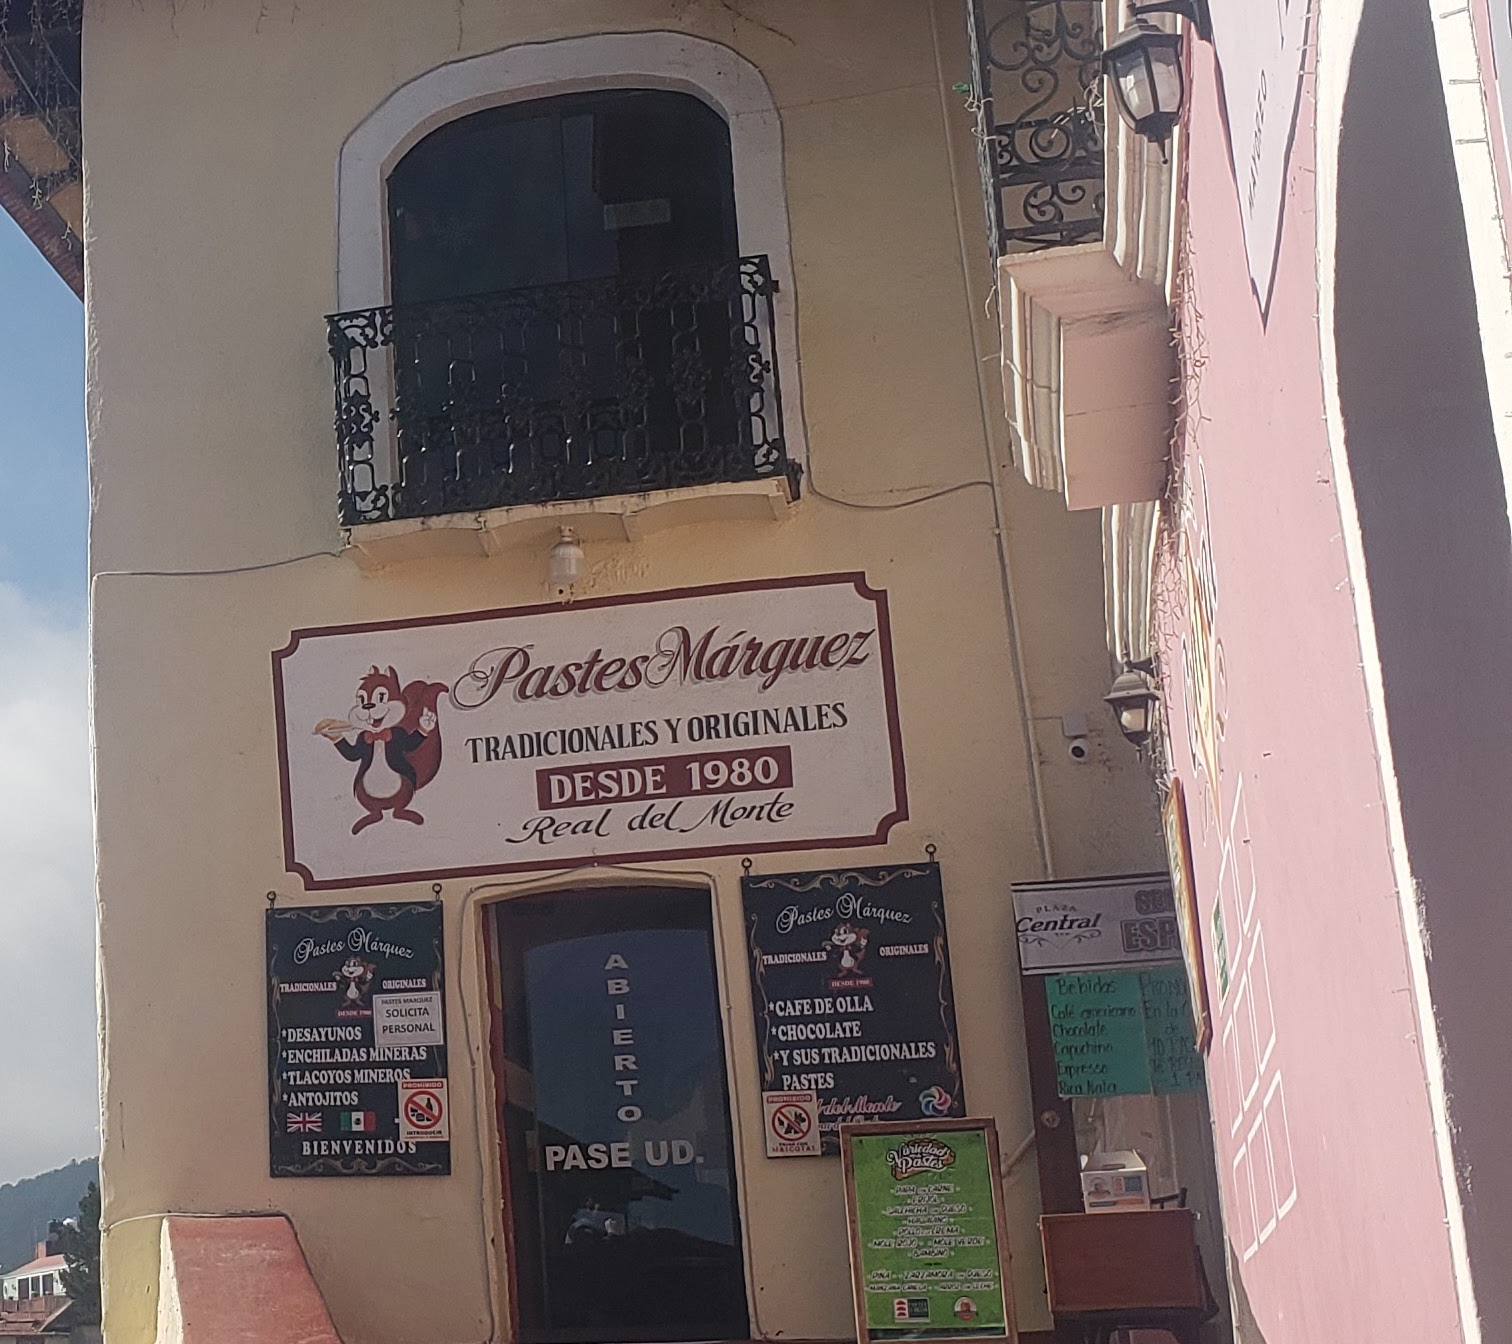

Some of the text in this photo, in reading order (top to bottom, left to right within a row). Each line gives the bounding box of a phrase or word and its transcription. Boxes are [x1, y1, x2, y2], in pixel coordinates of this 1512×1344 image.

[1247, 67, 1268, 220] MAYOREO
[451, 643, 650, 709] Pastes
[464, 702, 848, 763] TRADICIONALES Y ORIGINALES
[548, 756, 780, 804] DESDE 1980
[505, 791, 795, 844] Real del Monte
[776, 892, 912, 933] Pastes Márquez
[1036, 905, 1077, 913] PLAZA
[1016, 912, 1102, 933] Central
[293, 927, 414, 964] Pastes Márquez
[762, 943, 929, 965] TRADICIONALES ORIGINALES
[280, 978, 427, 993] TRADICIONALES ORIGINALES
[1055, 976, 1118, 996] Bebidas
[386, 1006, 430, 1018] SOLICITA
[775, 995, 874, 1016] CAFE DE OLLA
[287, 1026, 362, 1043] DESAYUNOS
[382, 1022, 436, 1034] PERSONAL
[604, 953, 642, 1122] ABIERTO
[777, 1020, 862, 1041] CHOCOLATE
[287, 1046, 427, 1064] ENCHILADAS MINERAS
[779, 1041, 936, 1066] Y SUS TRADICIONALES
[287, 1068, 411, 1085] TLACOYOS MINEROS
[782, 1072, 835, 1091] PASTES
[287, 1091, 359, 1107] ANTOJITOS
[302, 1140, 417, 1156] BIENVENIDOS
[545, 1139, 704, 1171] PASE UD.
